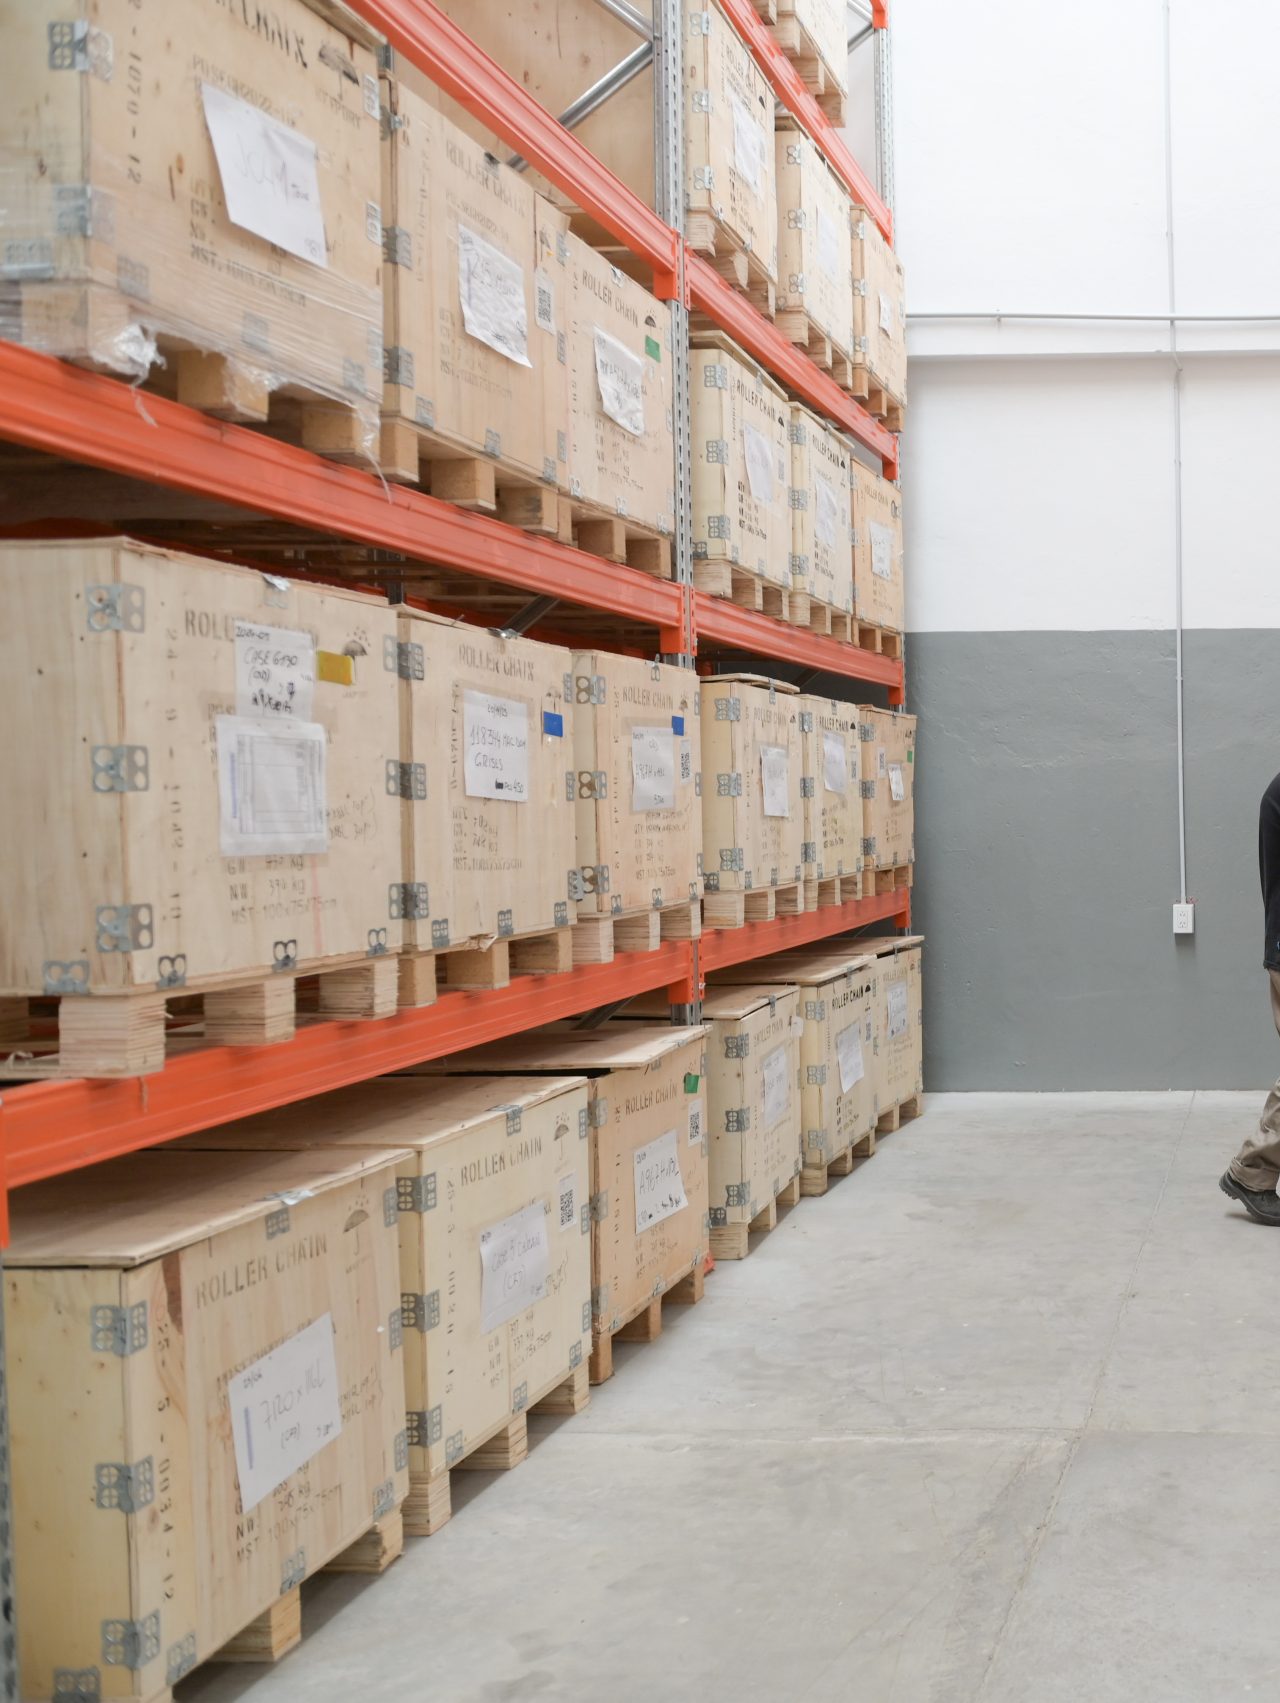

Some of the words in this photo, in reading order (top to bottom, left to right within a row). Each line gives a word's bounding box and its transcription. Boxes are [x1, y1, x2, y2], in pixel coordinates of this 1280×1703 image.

[582, 268, 612, 309] ROLLER
[615, 295, 639, 329] CHAIN
[737, 379, 758, 408] ROLLER
[759, 398, 776, 422] CHAIN
[459, 643, 500, 675] ROLLER
[503, 656, 535, 682] CHAIN
[622, 686, 650, 706] ROLLER
[652, 691, 673, 711] CHAIN
[832, 990, 849, 1011] ROLLER
[850, 983, 865, 1004] CHAIN
[625, 1091, 653, 1117] ROLLER
[655, 1077, 677, 1104] CHAIN
[461, 1151, 505, 1187] ROLLER
[510, 1136, 542, 1168] CHAIN
[195, 1256, 268, 1310] ROLLER
[275, 1232, 328, 1273] CHAIN
